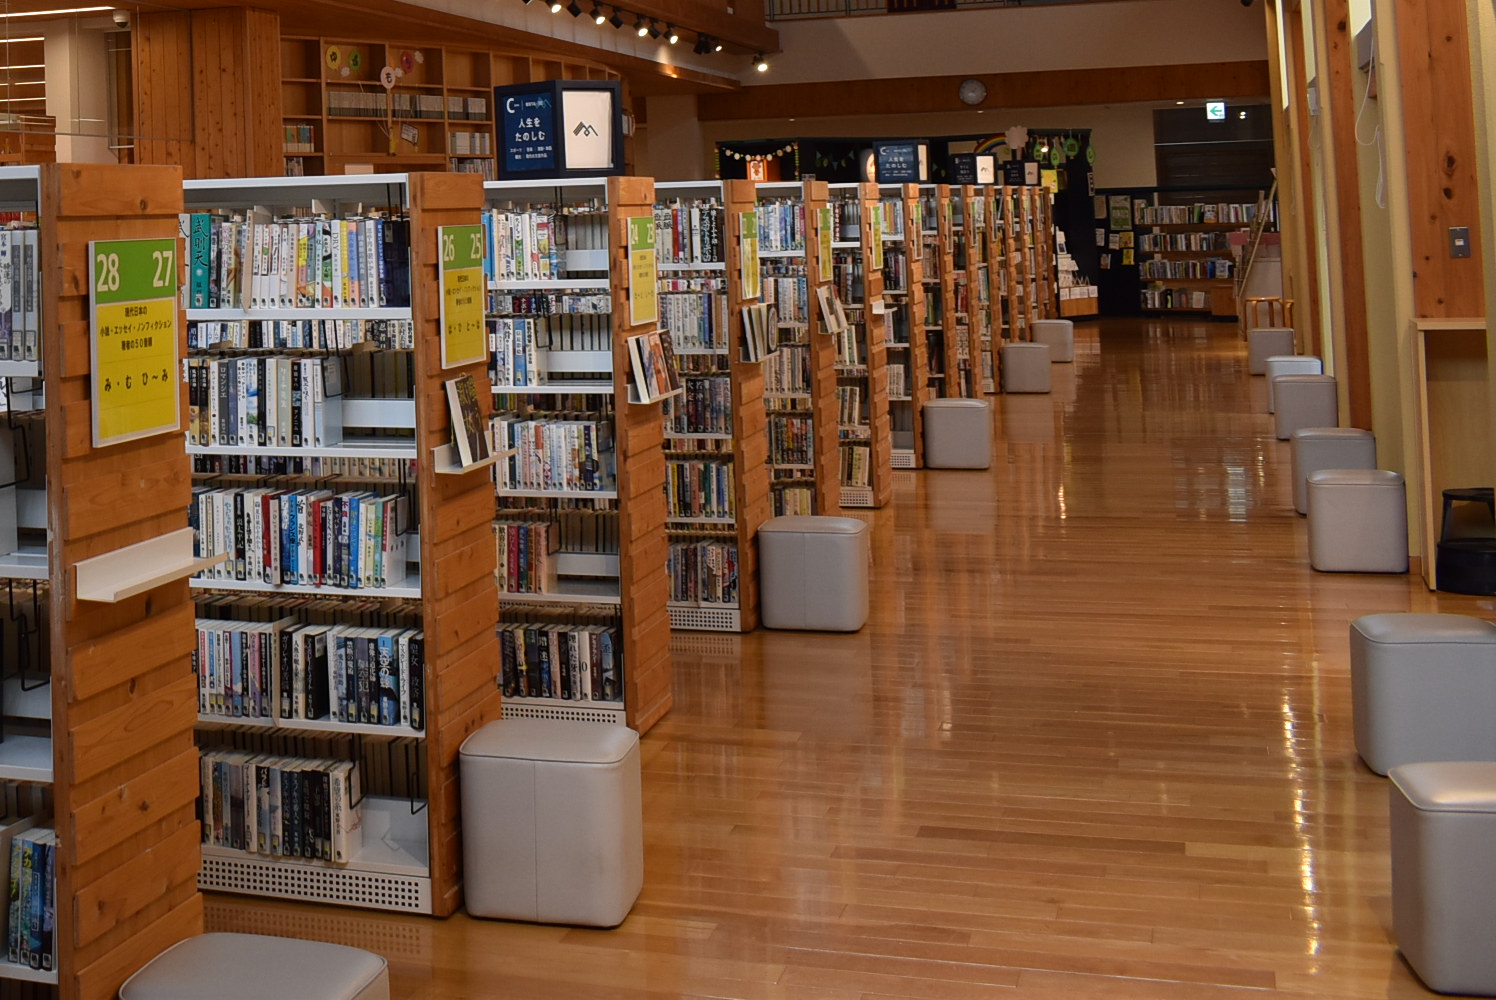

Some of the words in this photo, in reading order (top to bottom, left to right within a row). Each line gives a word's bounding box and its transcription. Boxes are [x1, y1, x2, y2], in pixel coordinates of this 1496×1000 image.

[506, 97, 515, 114] C
[515, 131, 546, 142] たのしむ
[518, 117, 540, 128] 人生を
[194, 217, 208, 267] 武則天
[444, 234, 455, 261] 26
[470, 233, 481, 259] 25
[97, 253, 120, 292] 28
[152, 250, 173, 288] 27
[378, 648, 391, 688] 天空の蜂
